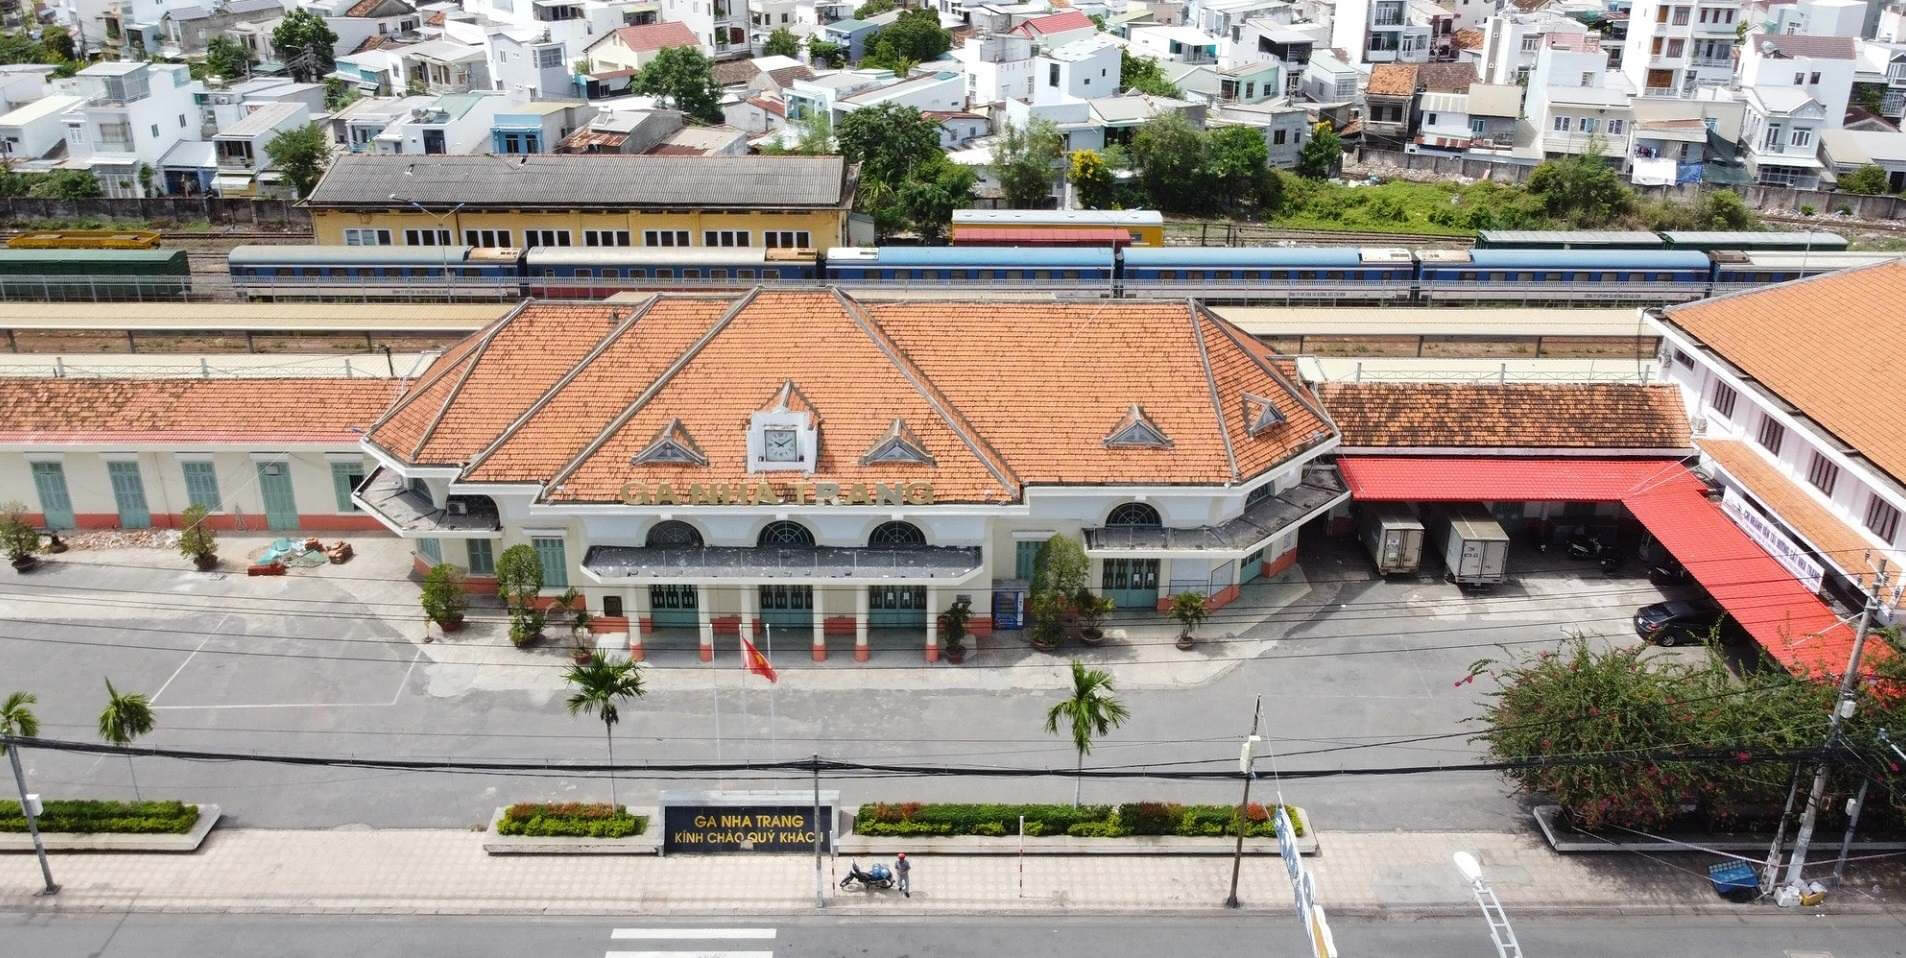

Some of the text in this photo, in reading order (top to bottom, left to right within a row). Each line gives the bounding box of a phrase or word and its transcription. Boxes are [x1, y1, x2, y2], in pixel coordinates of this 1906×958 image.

[620, 480, 934, 505] GA NHA TRANG
[694, 815, 804, 828] GA NHA TRANG
[674, 829, 703, 843] KÍNH
[707, 829, 744, 843] CHÀO
[747, 829, 776, 843] QUÝ
